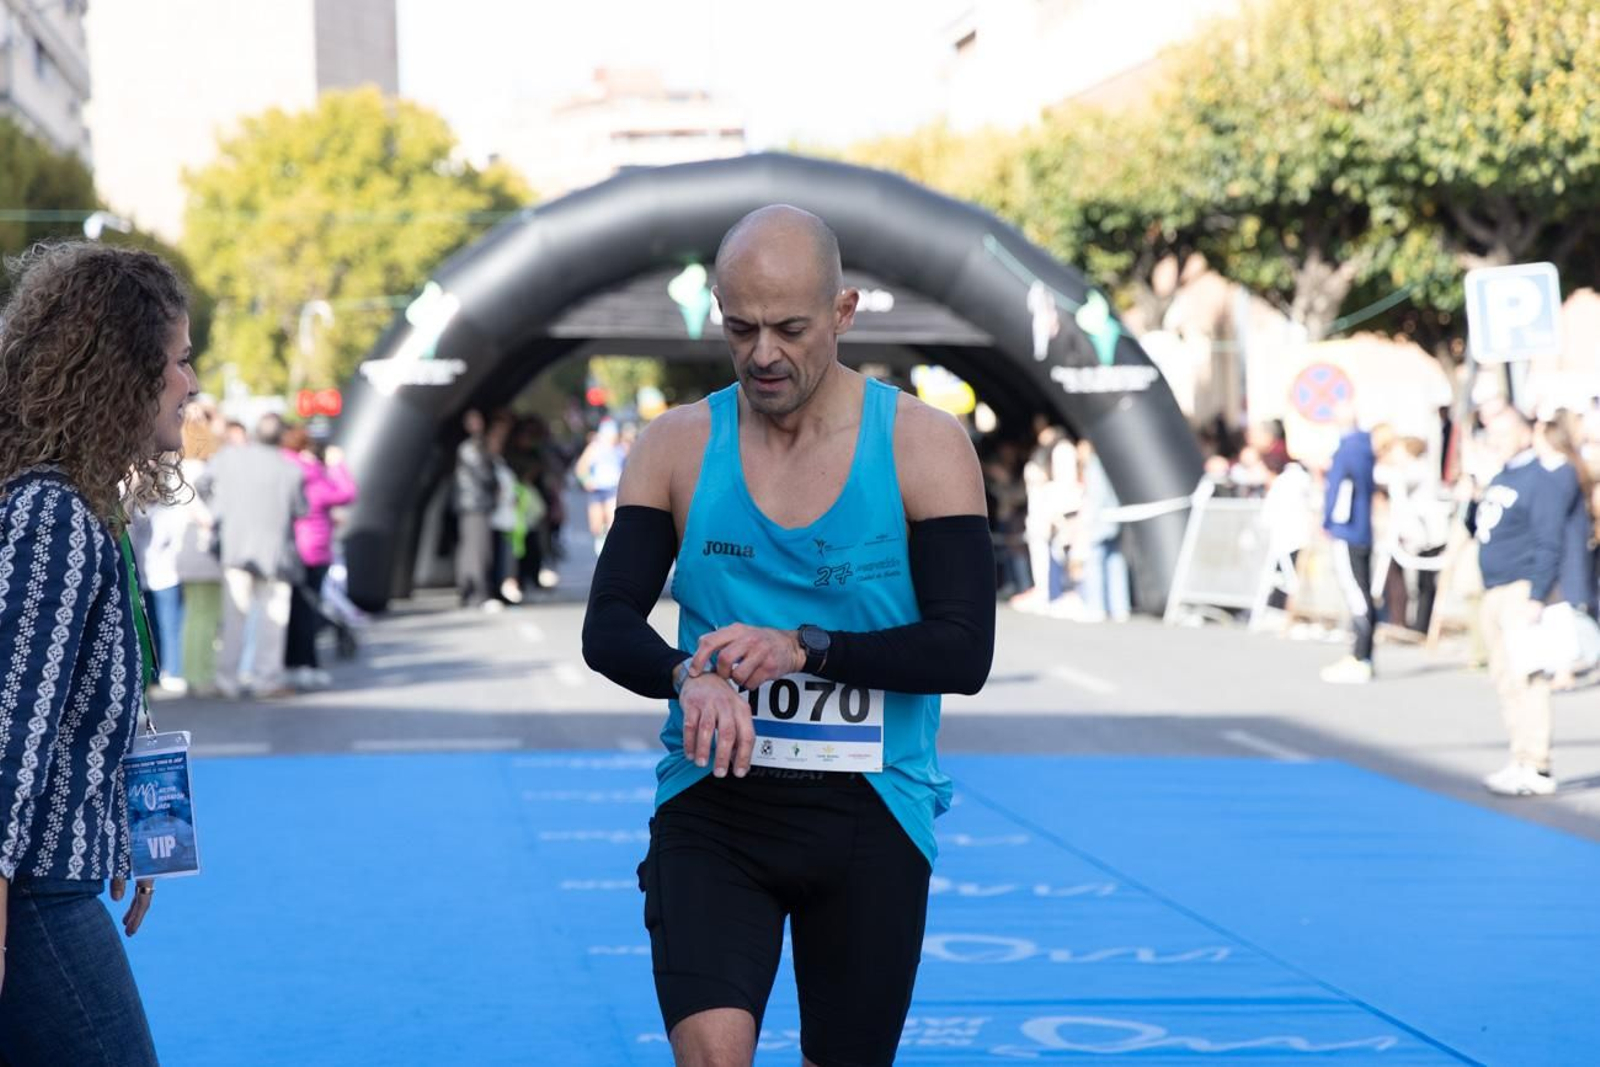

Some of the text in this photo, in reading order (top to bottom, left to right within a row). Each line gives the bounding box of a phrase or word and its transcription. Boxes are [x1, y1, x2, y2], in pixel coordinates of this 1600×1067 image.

[1484, 276, 1543, 350] P
[814, 561, 853, 587] 27
[738, 678, 870, 723] 1070
[147, 835, 176, 859] VIP
